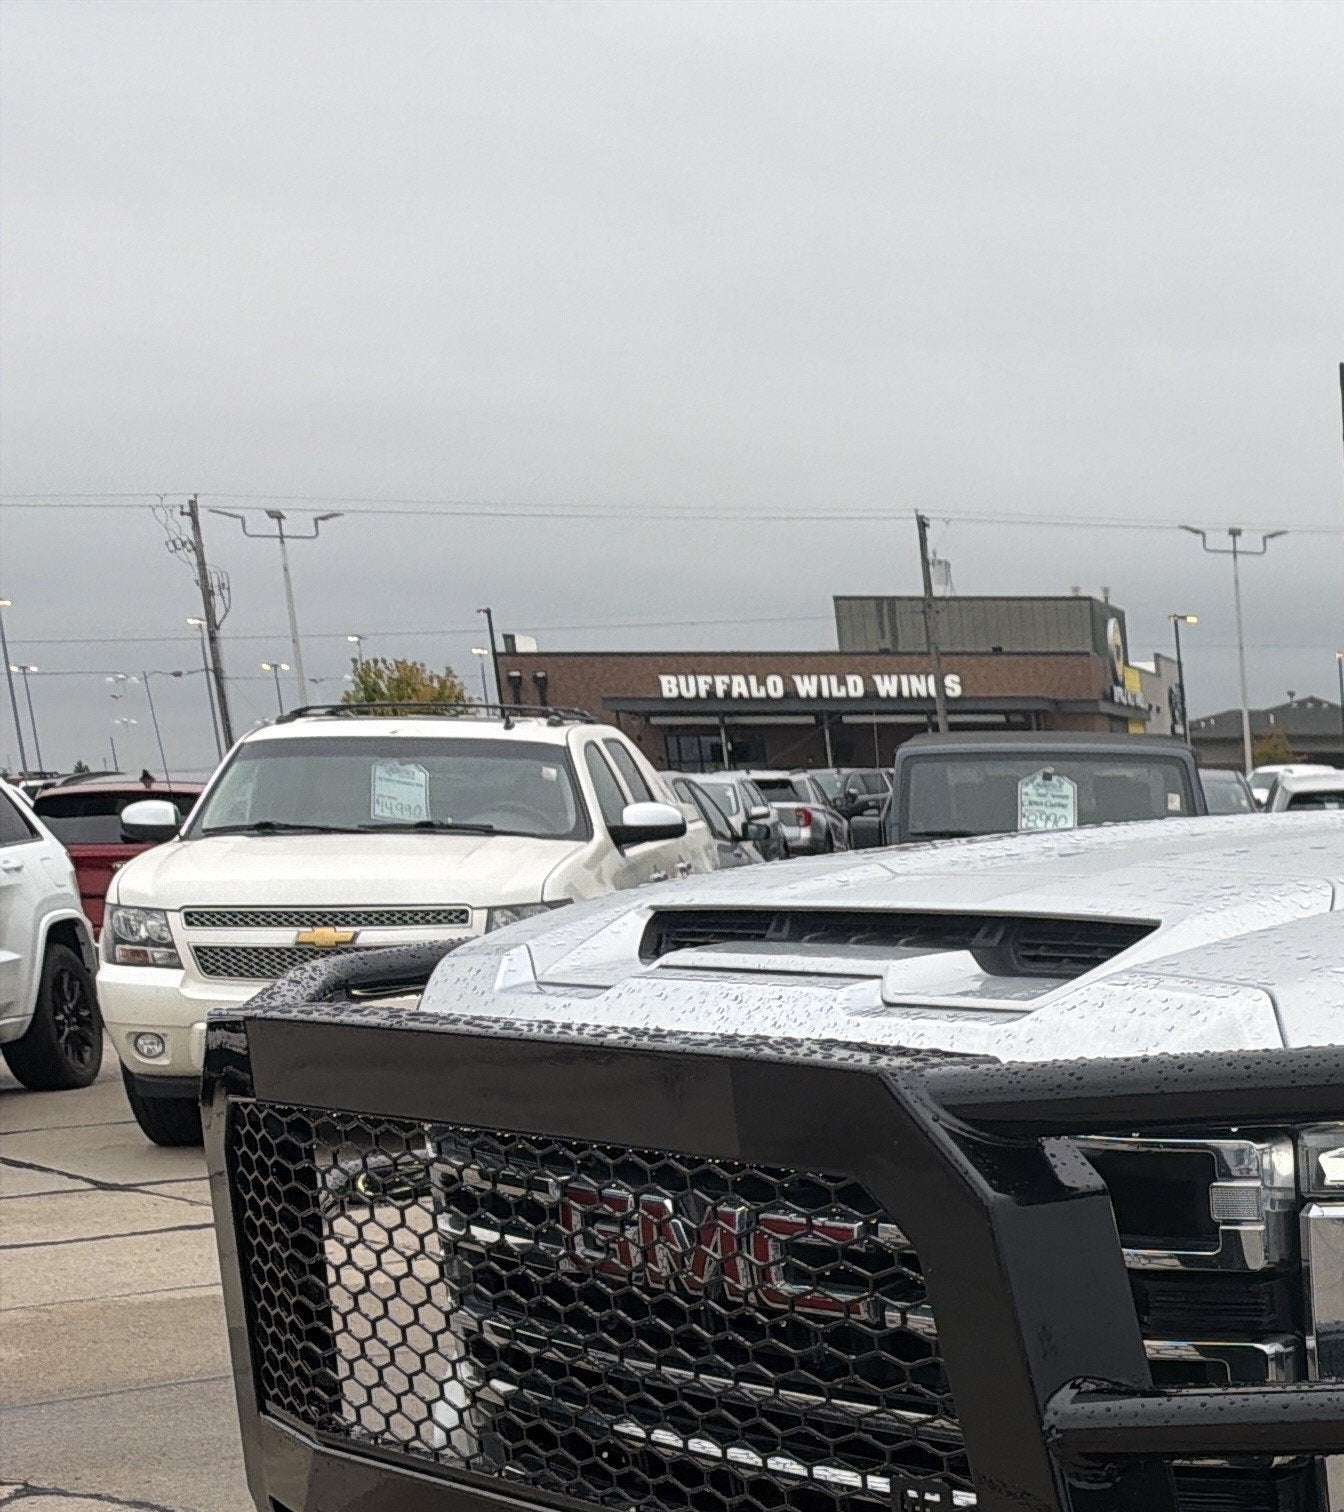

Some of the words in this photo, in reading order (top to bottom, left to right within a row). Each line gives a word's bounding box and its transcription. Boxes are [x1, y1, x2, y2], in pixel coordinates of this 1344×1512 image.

[658, 674, 785, 699] BUFFALO
[791, 674, 865, 699] WILD
[557, 1180, 872, 1322] GMC
